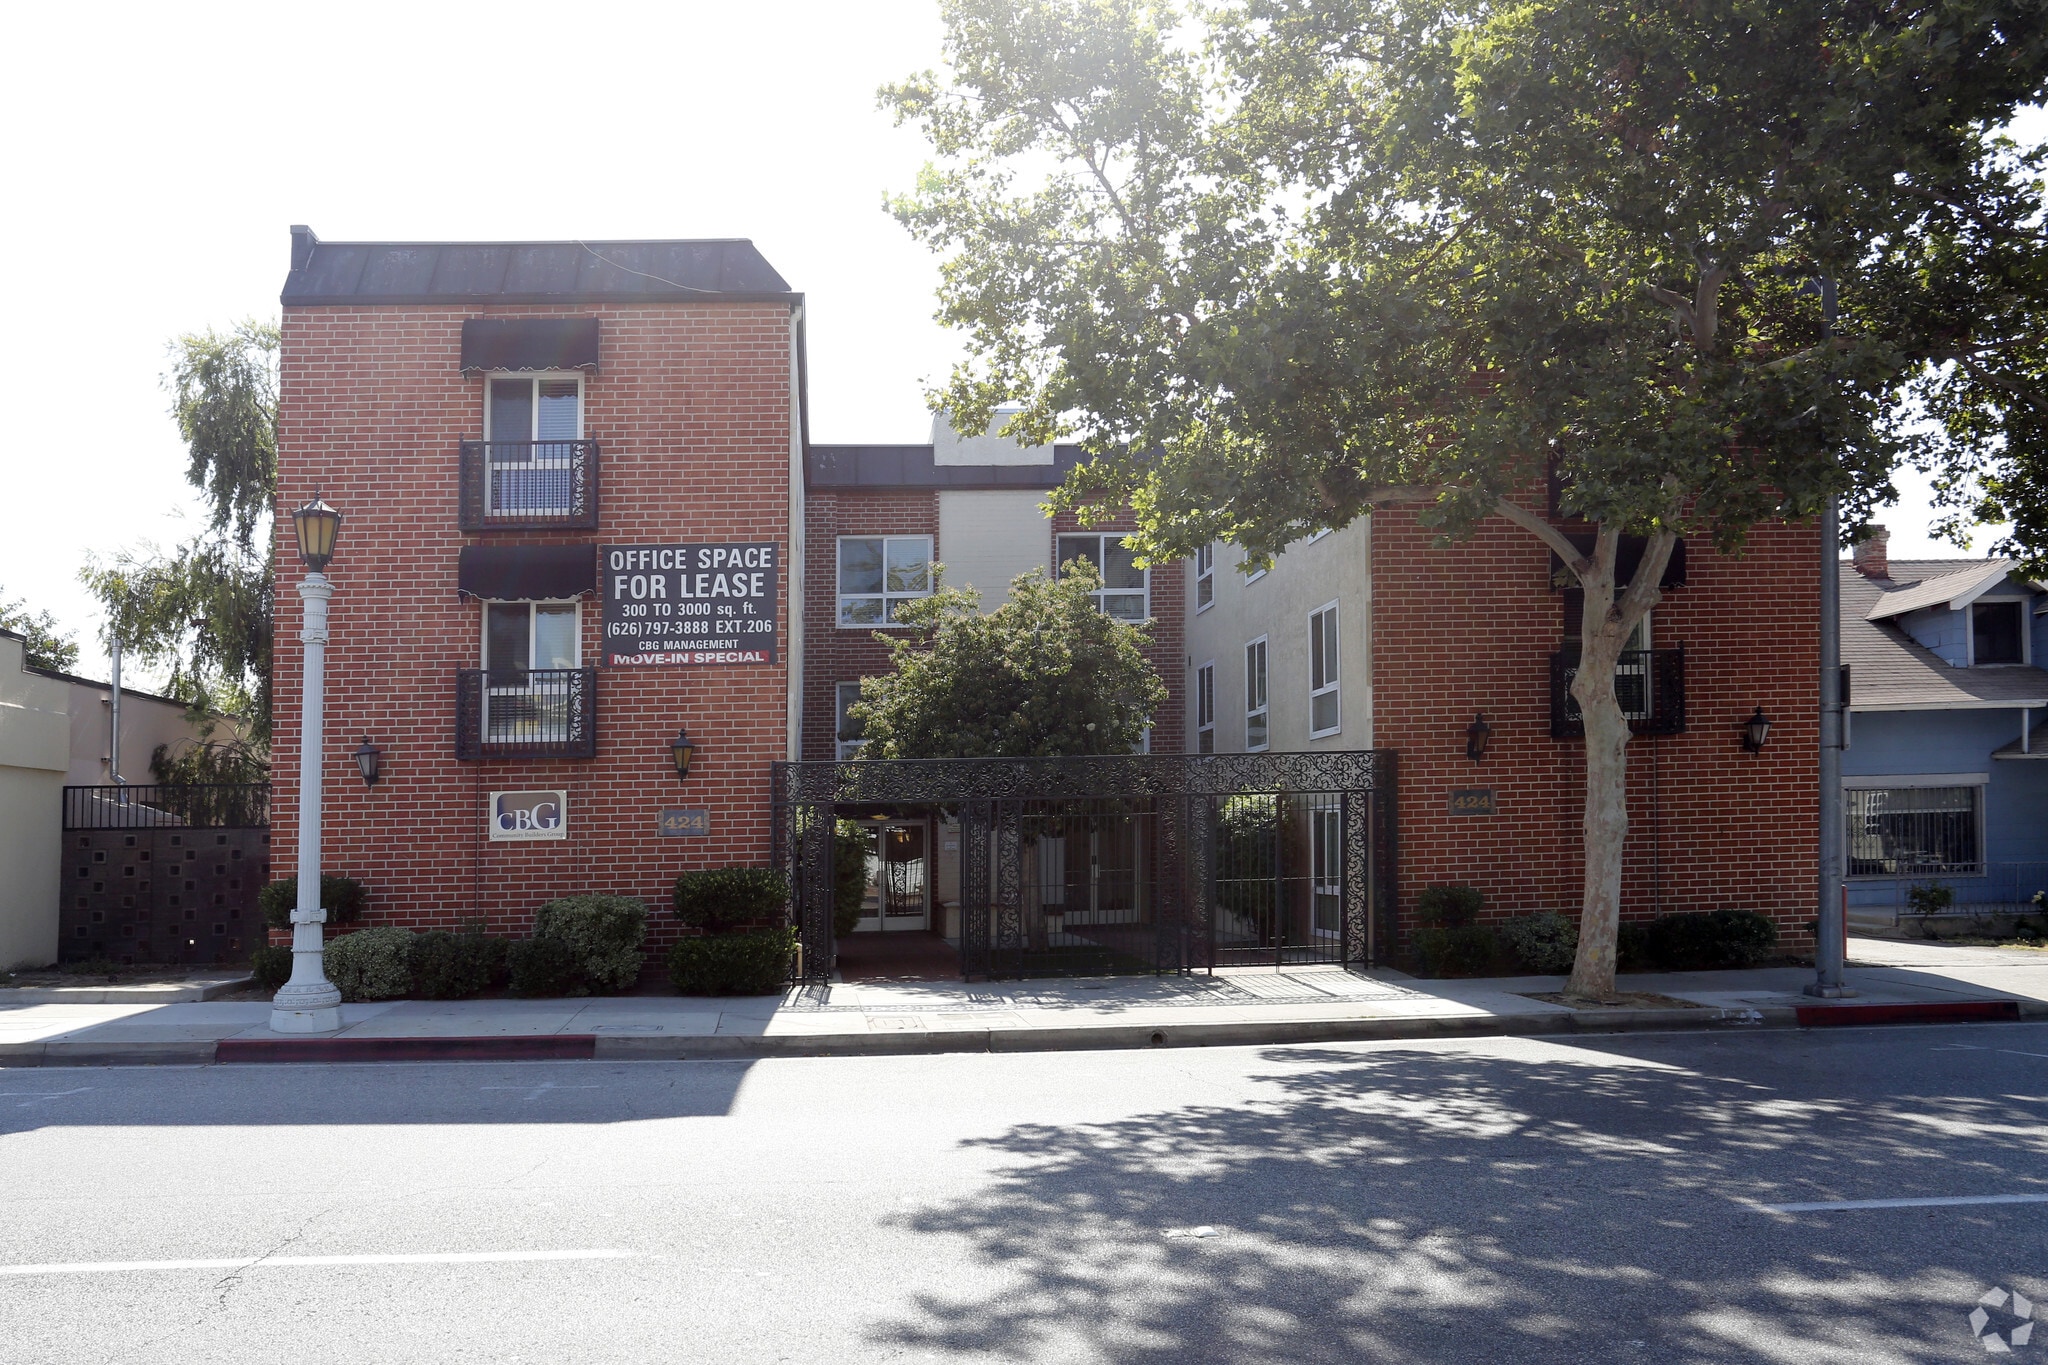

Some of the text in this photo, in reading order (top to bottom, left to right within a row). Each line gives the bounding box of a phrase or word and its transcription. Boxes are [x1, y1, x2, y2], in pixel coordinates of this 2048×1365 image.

[610, 547, 772, 571] OFFICE SPACE
[614, 572, 765, 600] FOR LEASE
[622, 601, 757, 618] 300 TO 3000 sq. ft.
[638, 639, 739, 650] CBG MANAGEMENT
[613, 651, 765, 665] MOVE-IN SPECIAL
[1454, 795, 1490, 809] 424
[497, 802, 557, 832] CBG
[664, 815, 704, 829] 424
